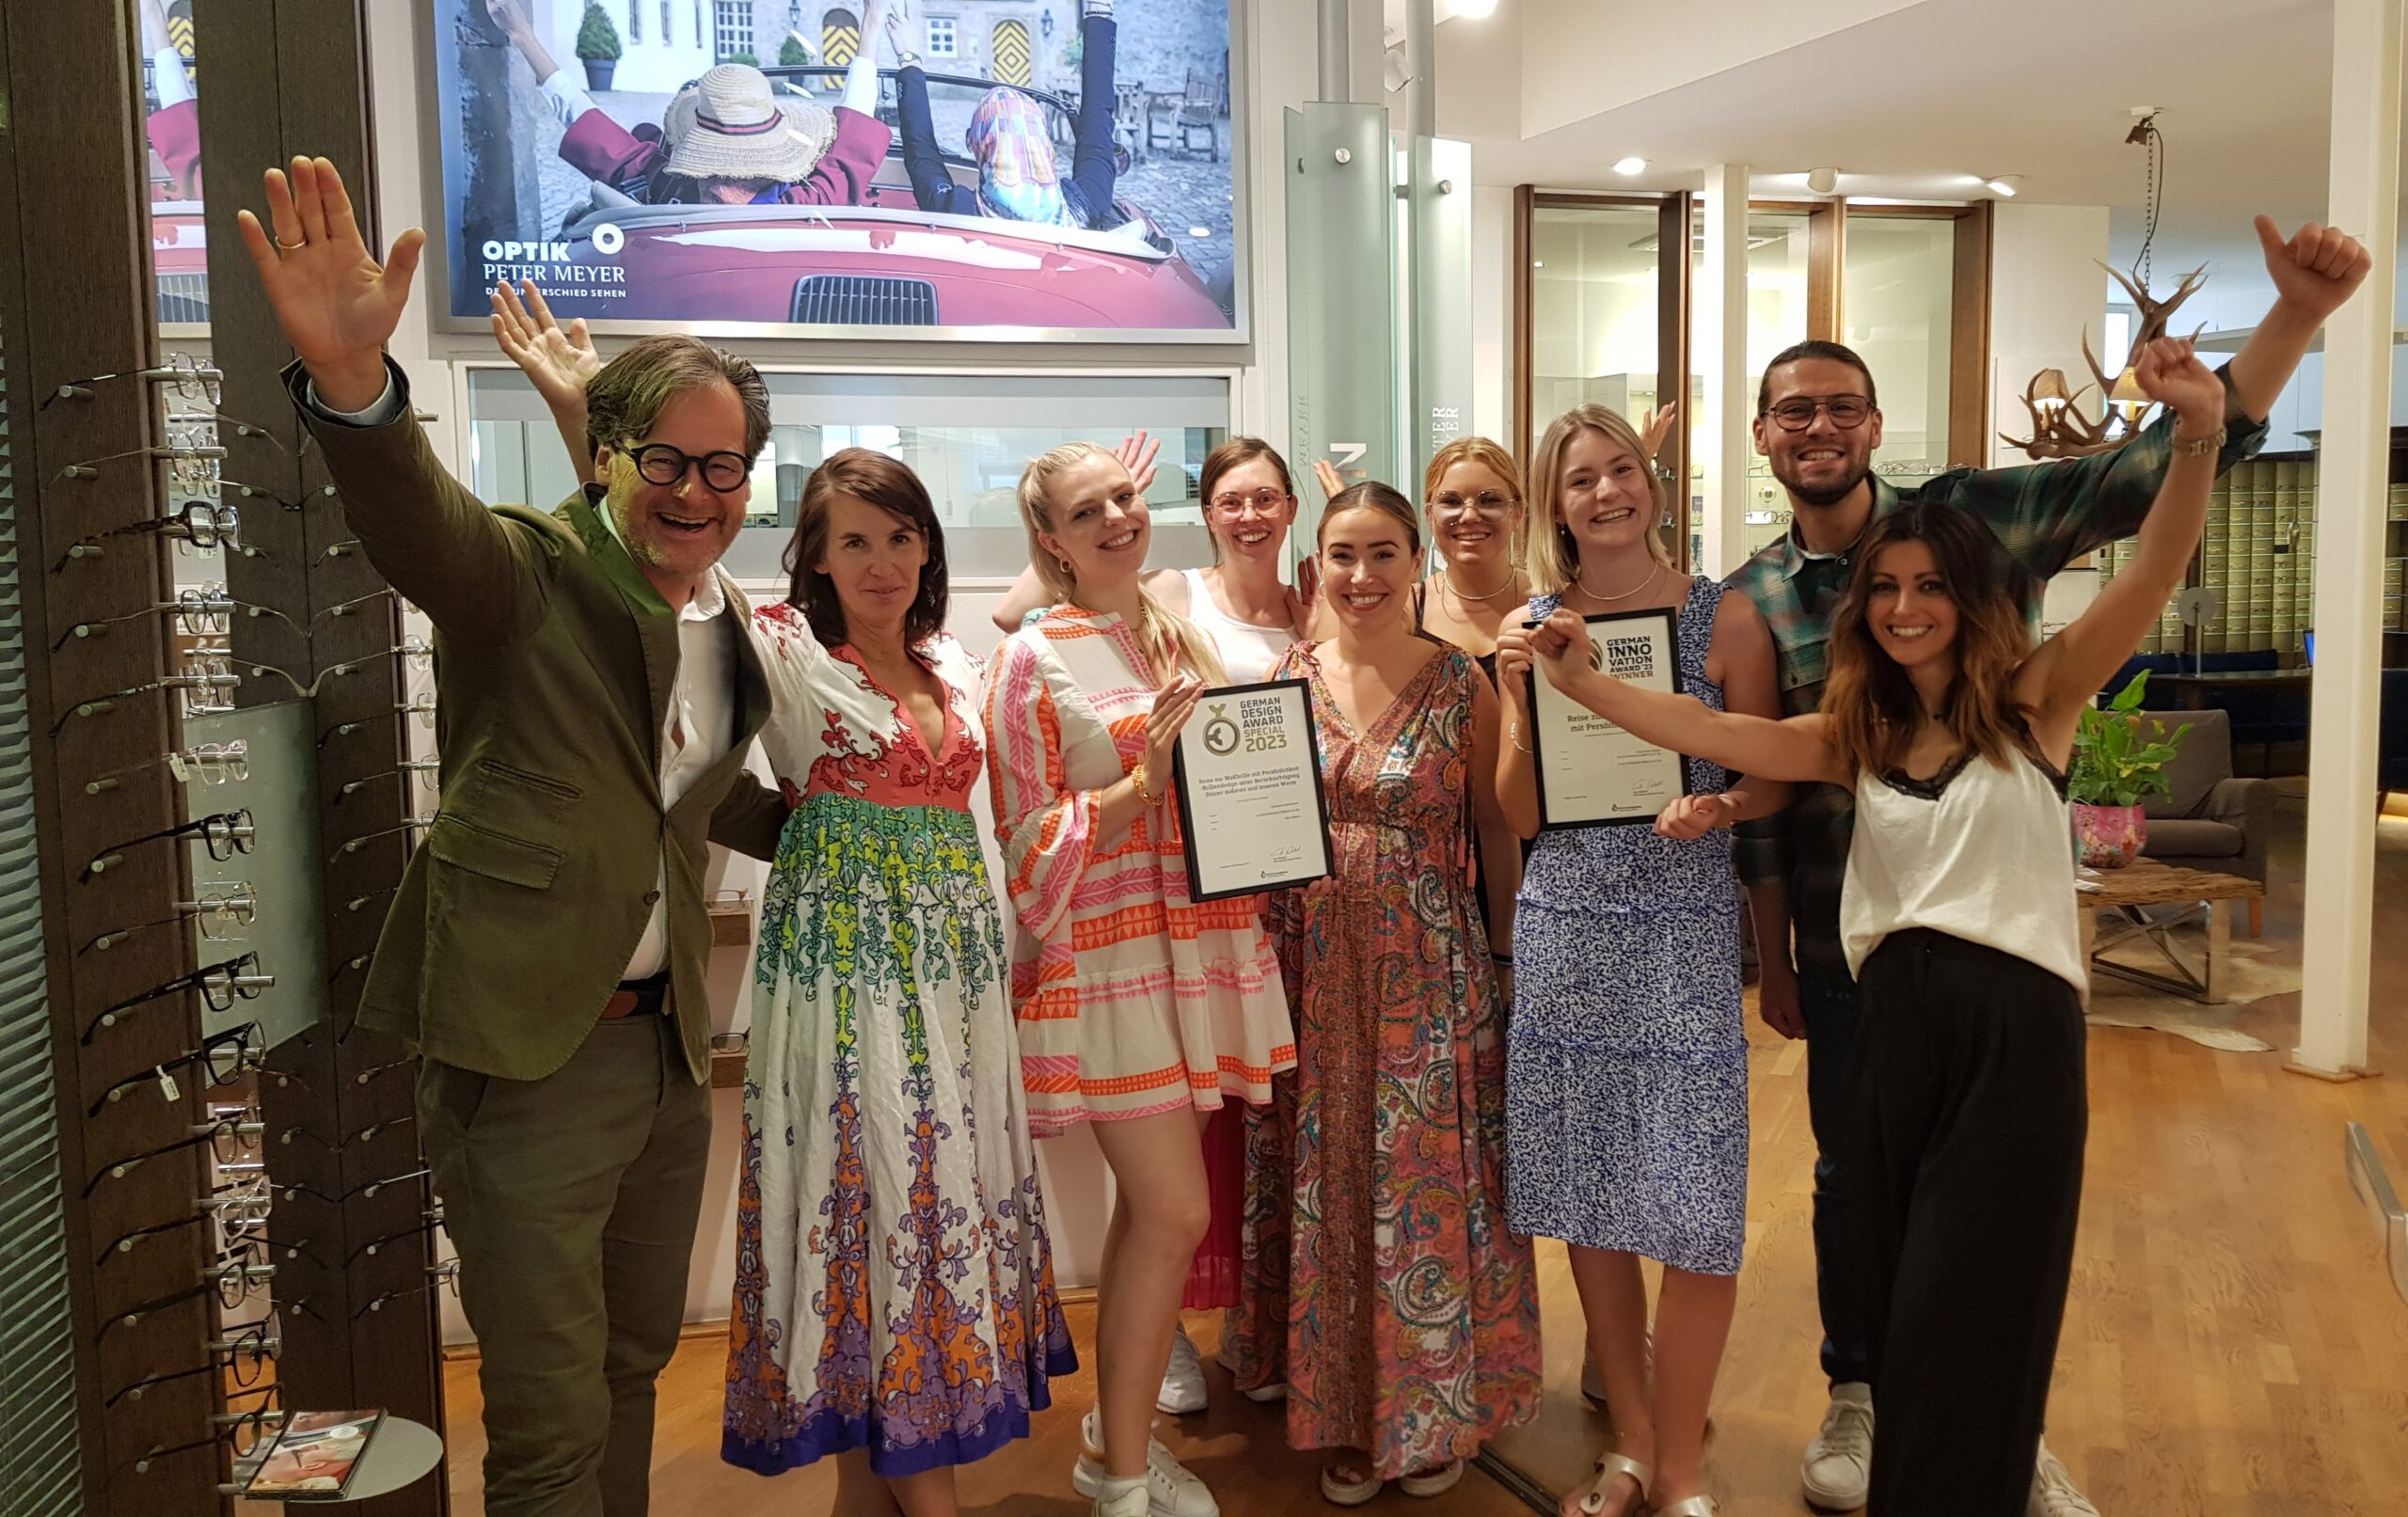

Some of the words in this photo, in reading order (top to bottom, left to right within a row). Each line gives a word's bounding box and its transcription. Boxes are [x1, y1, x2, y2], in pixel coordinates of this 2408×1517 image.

[482, 240, 572, 262] OPTIK
[483, 263, 547, 281] PETER
[553, 265, 626, 283] MEYER
[515, 288, 588, 297] UNERSCHIED
[591, 289, 626, 298] SEHEN
[1607, 636, 1651, 646] GERMAN
[1607, 643, 1652, 658] INNO
[1608, 656, 1653, 667] VATION
[1609, 665, 1641, 673] AWARD
[1609, 670, 1656, 680] WINNER
[1240, 696, 1281, 709] GERMAN
[1242, 705, 1282, 719] DESIGN
[1243, 715, 1284, 729] AWARD
[1566, 715, 1590, 723] Reise
[1244, 725, 1285, 738] SPECIAL
[1570, 723, 1584, 733] mit
[1244, 734, 1288, 752] 2023
